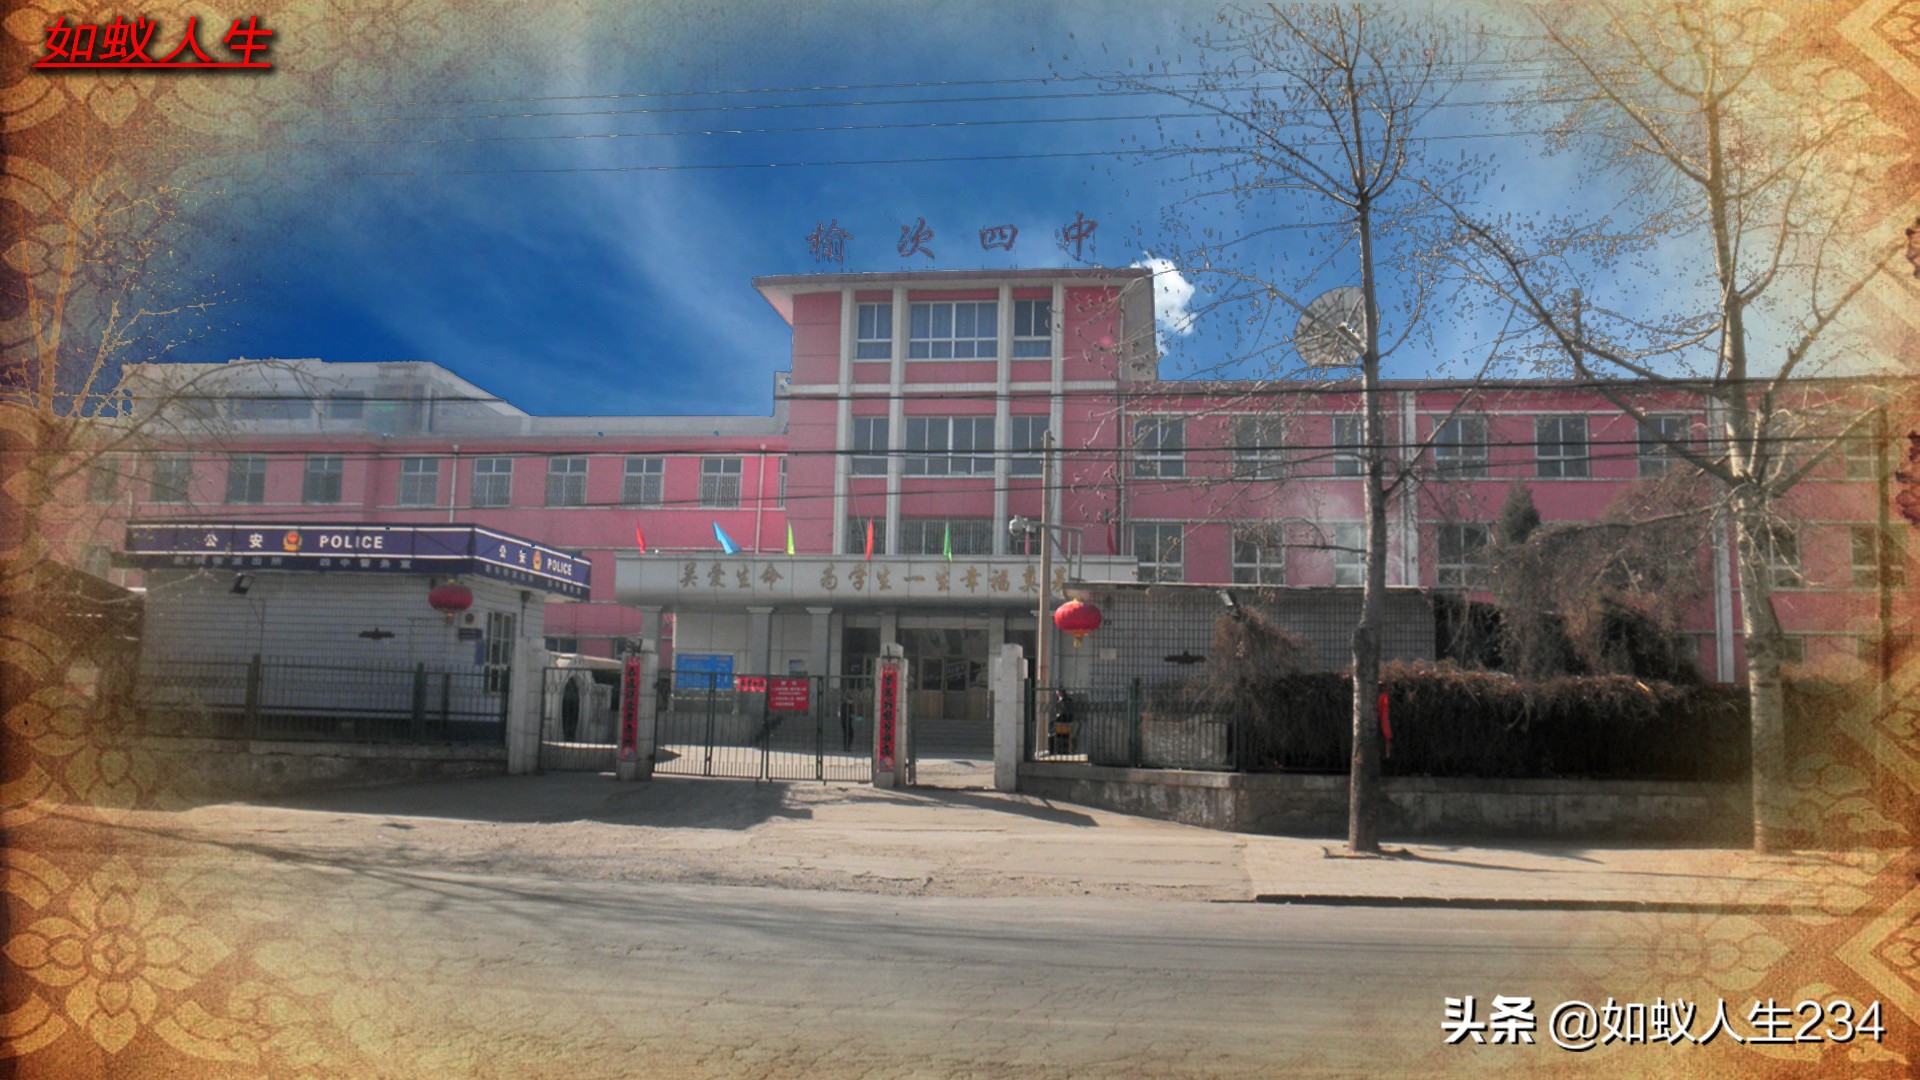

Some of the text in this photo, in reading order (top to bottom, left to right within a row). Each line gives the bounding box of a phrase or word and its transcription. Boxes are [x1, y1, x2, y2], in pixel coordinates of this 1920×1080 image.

[805, 209, 1098, 264] 榆次四中
[204, 533, 384, 551] 公安 POLICE
[498, 544, 526, 565] 公安
[547, 558, 572, 575] POLICE
[679, 563, 785, 590] 关爱生命
